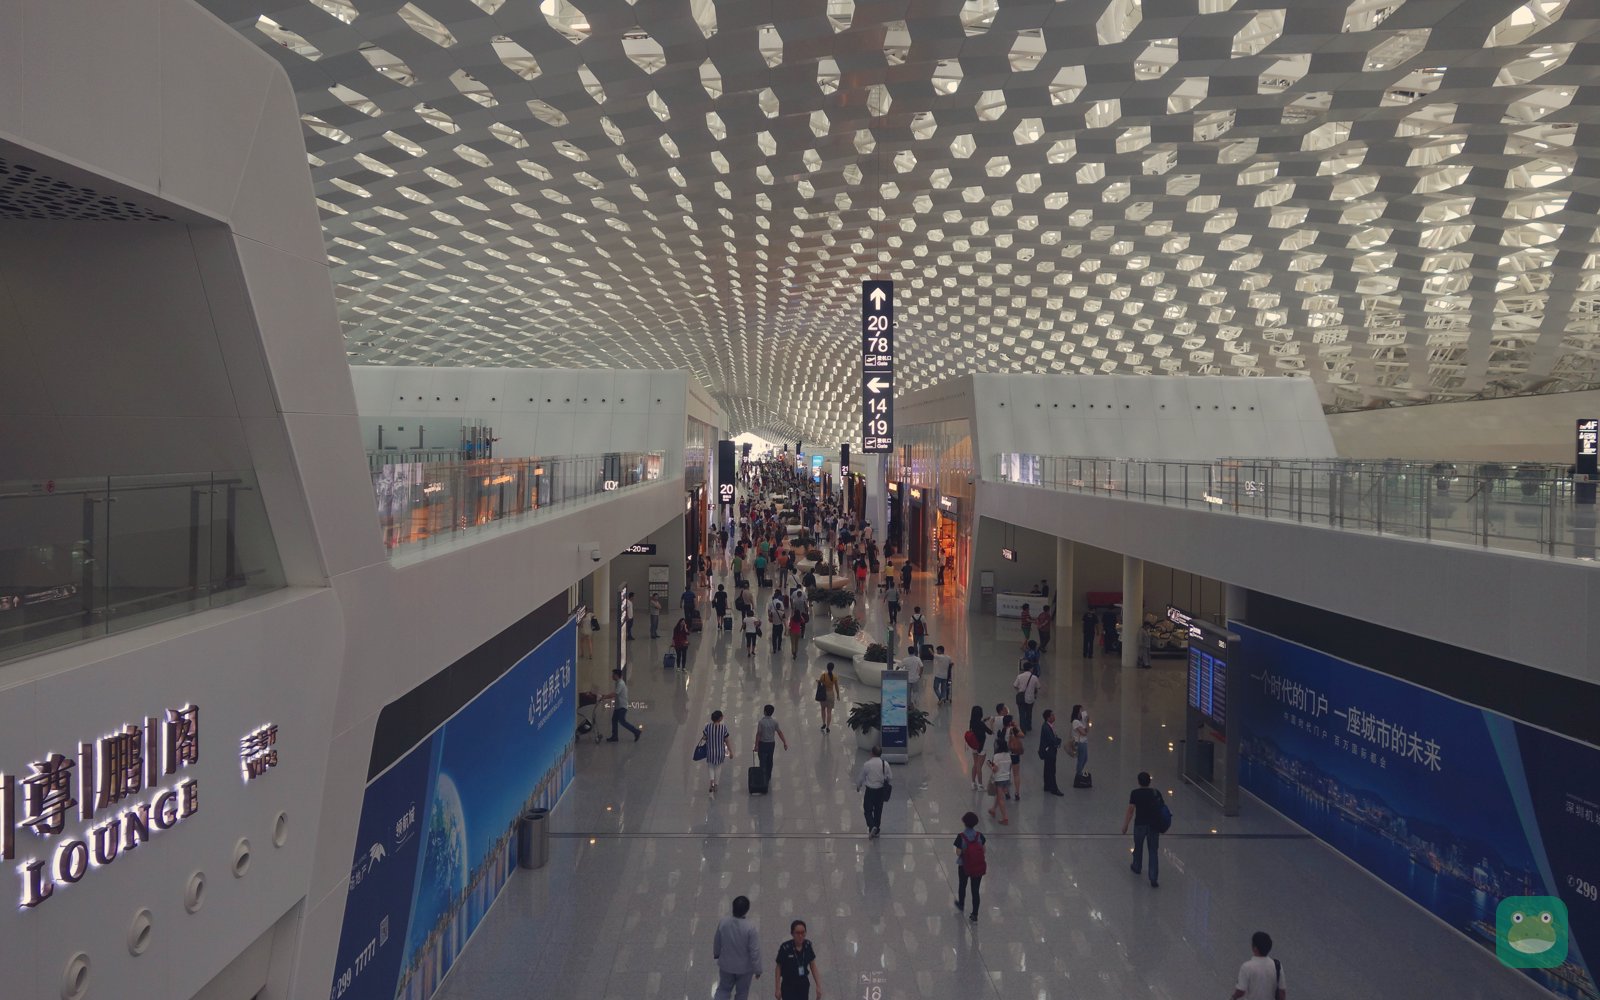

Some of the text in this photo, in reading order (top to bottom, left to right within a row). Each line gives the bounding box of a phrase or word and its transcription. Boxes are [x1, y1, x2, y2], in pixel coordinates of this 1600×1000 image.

[868, 316, 888, 331] 20
[868, 338, 888, 353] 78
[868, 398, 887, 413] 14
[868, 420, 887, 435] 19
[719, 483, 734, 494] 20
[1249, 669, 1329, 718] 一个时代的门户
[1333, 706, 1442, 772] 一座城市的未来
[18, 779, 198, 908] LOUNGE
[1576, 877, 1598, 902] 299
[336, 937, 376, 999] 299 77777
